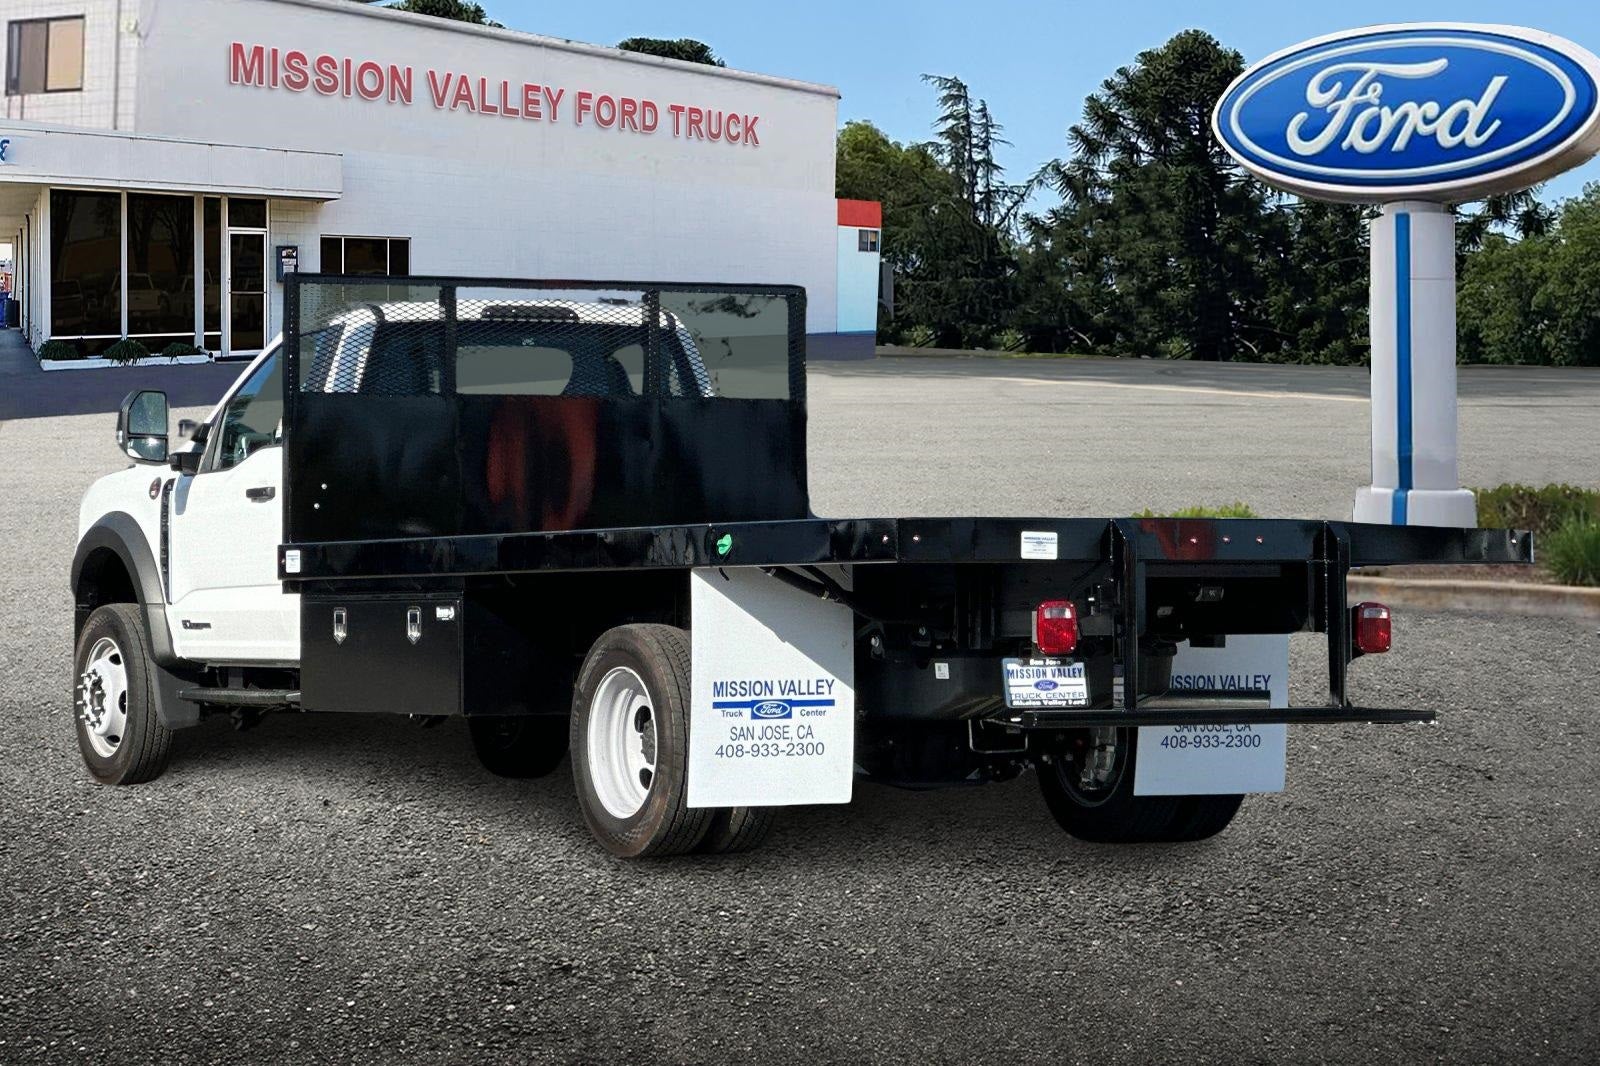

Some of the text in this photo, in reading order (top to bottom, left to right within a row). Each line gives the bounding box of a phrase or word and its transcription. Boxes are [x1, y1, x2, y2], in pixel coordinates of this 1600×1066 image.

[229, 42, 761, 146] MISSION VALLEY FORD TRUCK
[1286, 58, 1508, 156] Ford
[1007, 668, 1082, 679] MISSION VALLEY
[713, 679, 835, 697] MISSION VALLEY
[1171, 674, 1271, 689] ISSION VALLEY
[721, 710, 743, 718] Truck
[760, 703, 783, 714] Ford
[800, 708, 826, 717] Center
[730, 724, 814, 741] SAN JOSE, CA
[1160, 734, 1262, 749] 408-933-2300
[715, 742, 825, 758] 408-933-2300
